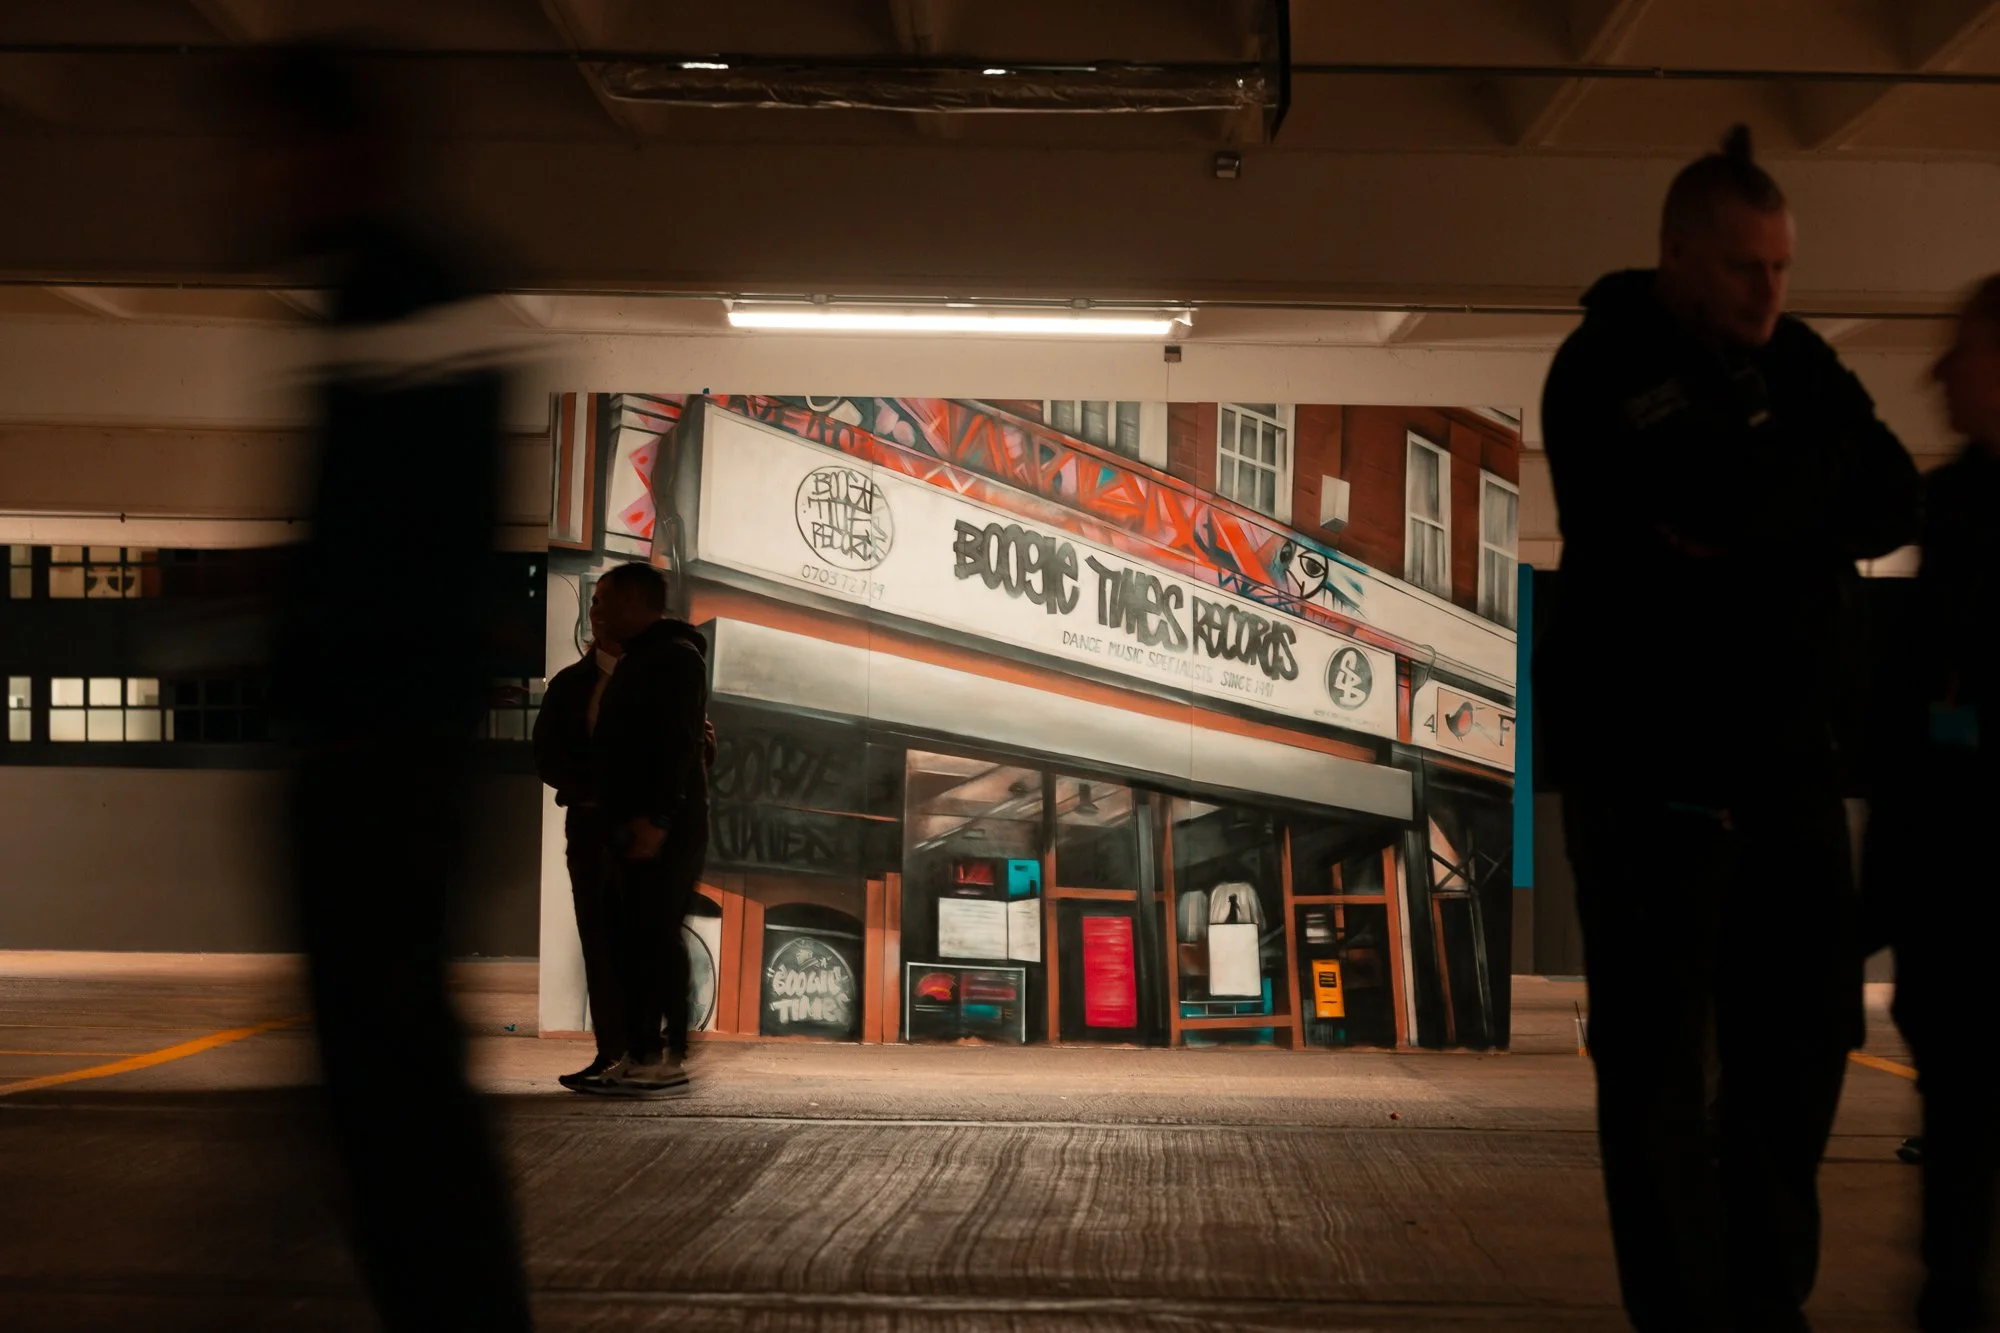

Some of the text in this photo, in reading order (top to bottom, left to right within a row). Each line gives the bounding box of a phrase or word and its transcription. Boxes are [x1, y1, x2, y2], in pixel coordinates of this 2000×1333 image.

[1062, 630, 1103, 653] DANCE
[1108, 641, 1144, 665] MUSIC
[1220, 670, 1253, 693] SINCE
